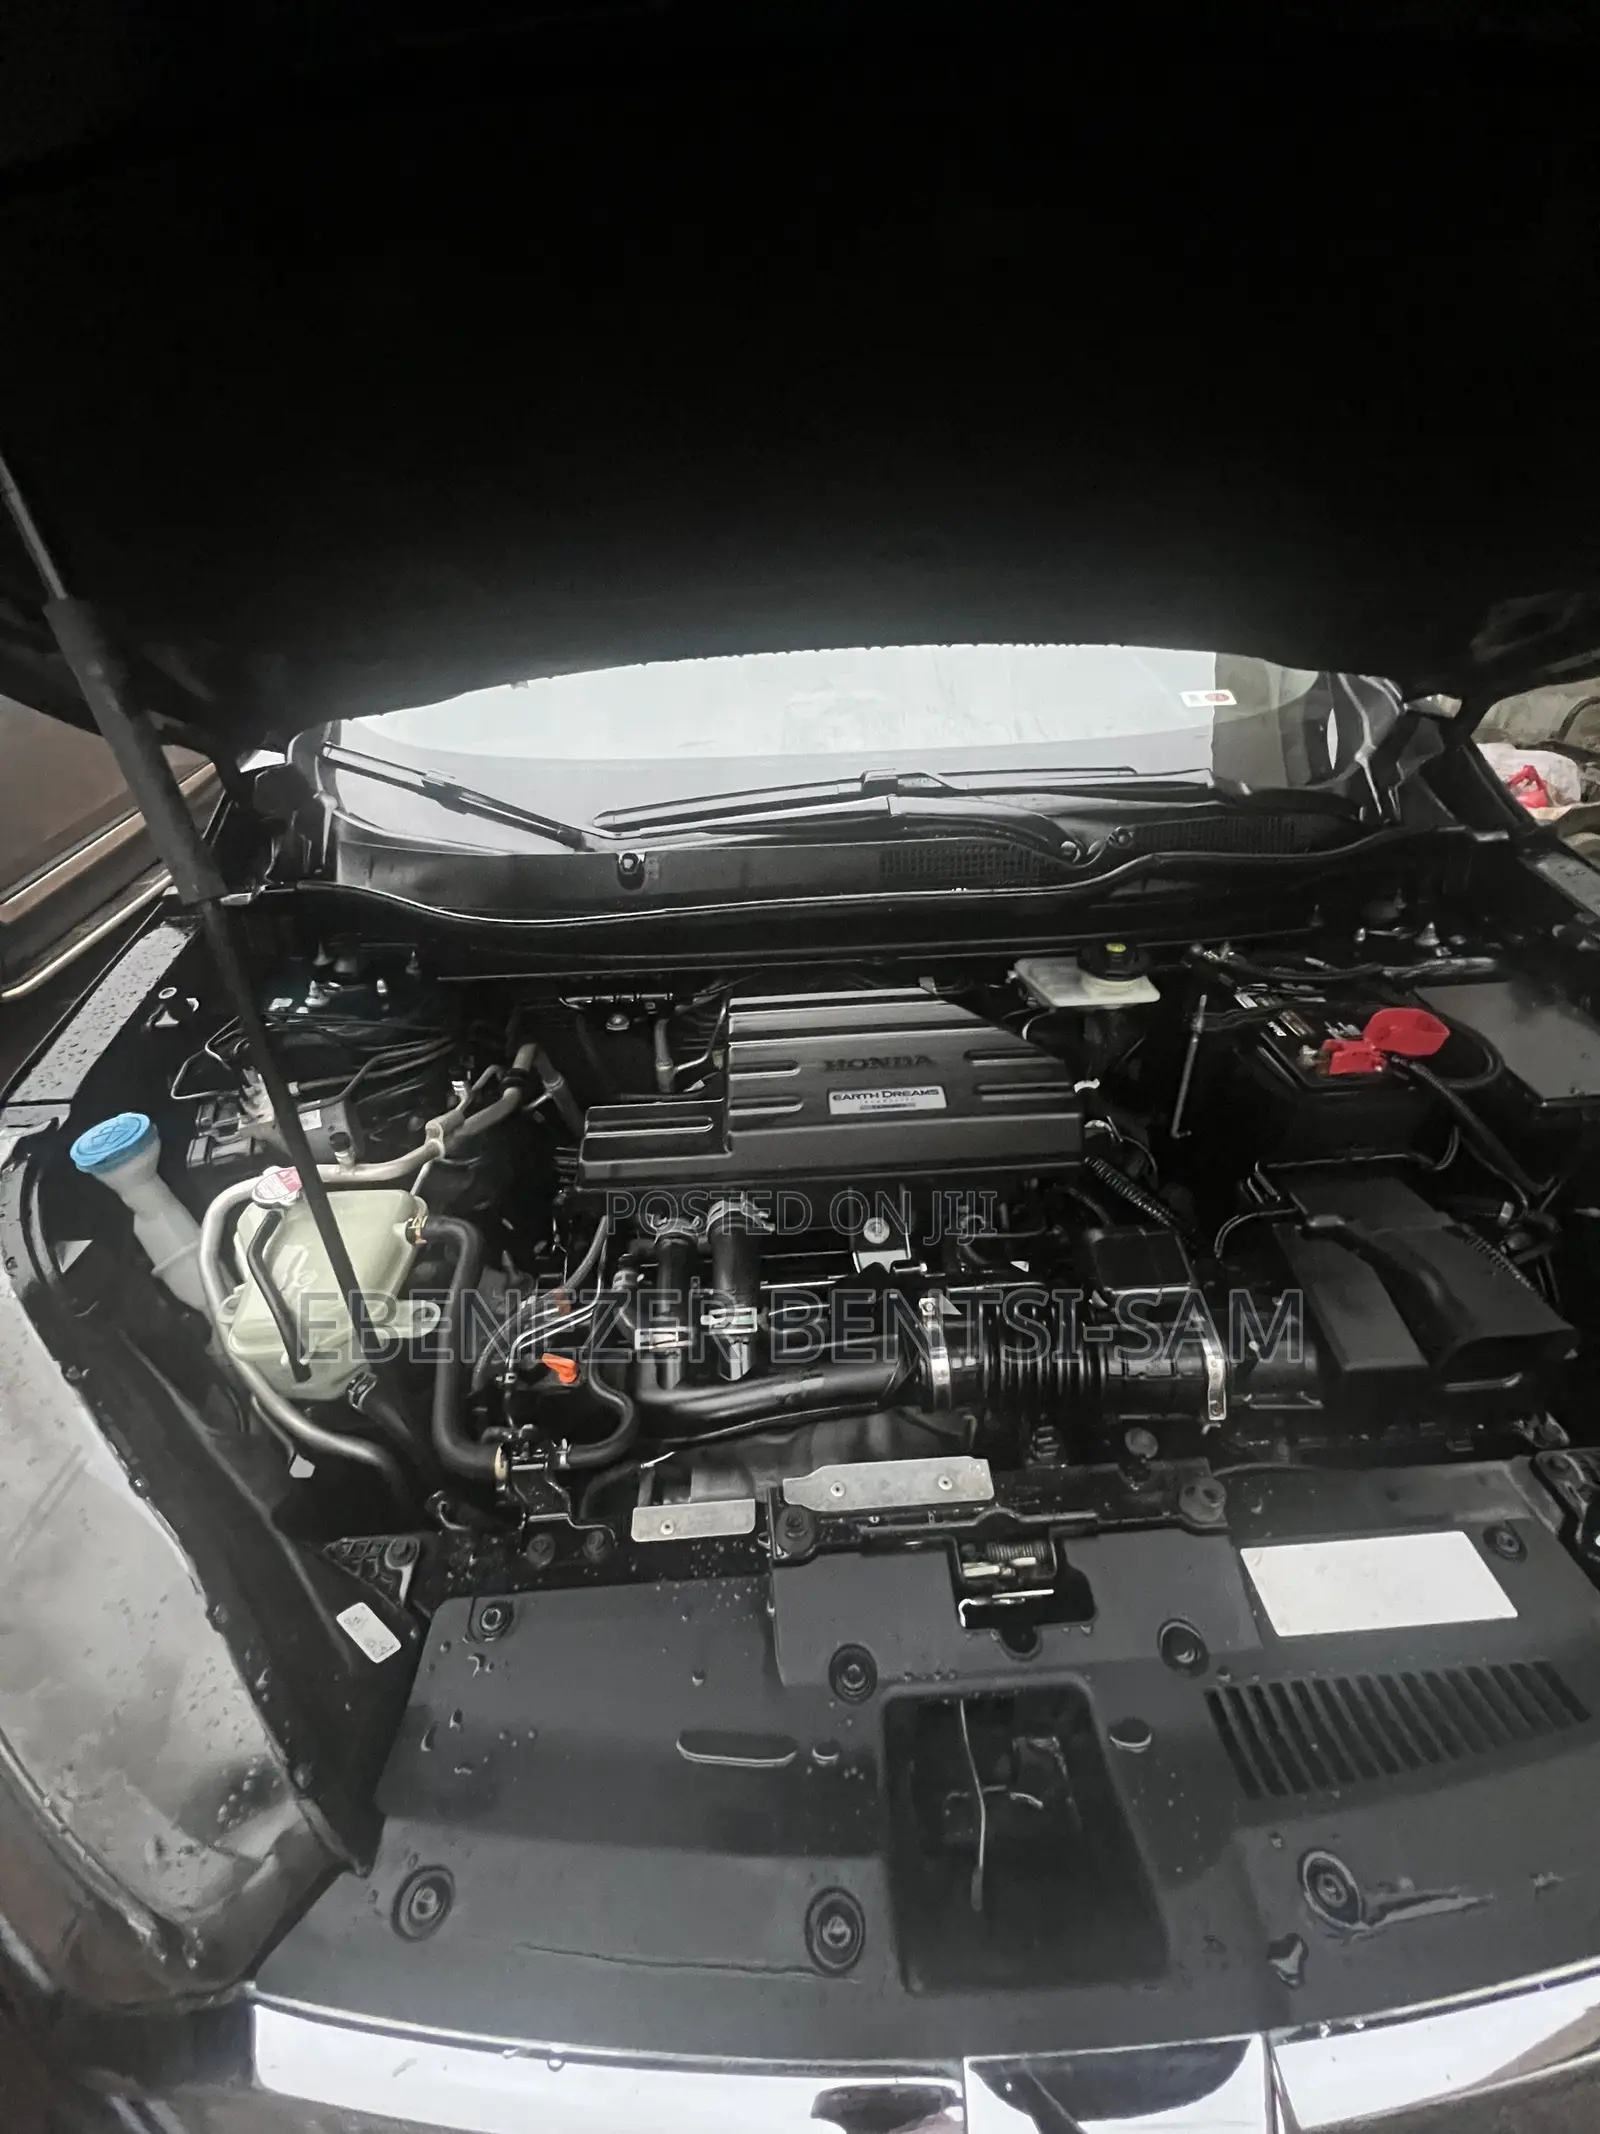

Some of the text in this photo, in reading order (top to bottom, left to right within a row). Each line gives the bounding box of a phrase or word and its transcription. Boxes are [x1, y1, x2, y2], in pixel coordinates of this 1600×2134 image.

[823, 1054, 936, 1072] HONDA
[832, 1091, 879, 1101] EARTH
[882, 1088, 940, 1098] DREAMS
